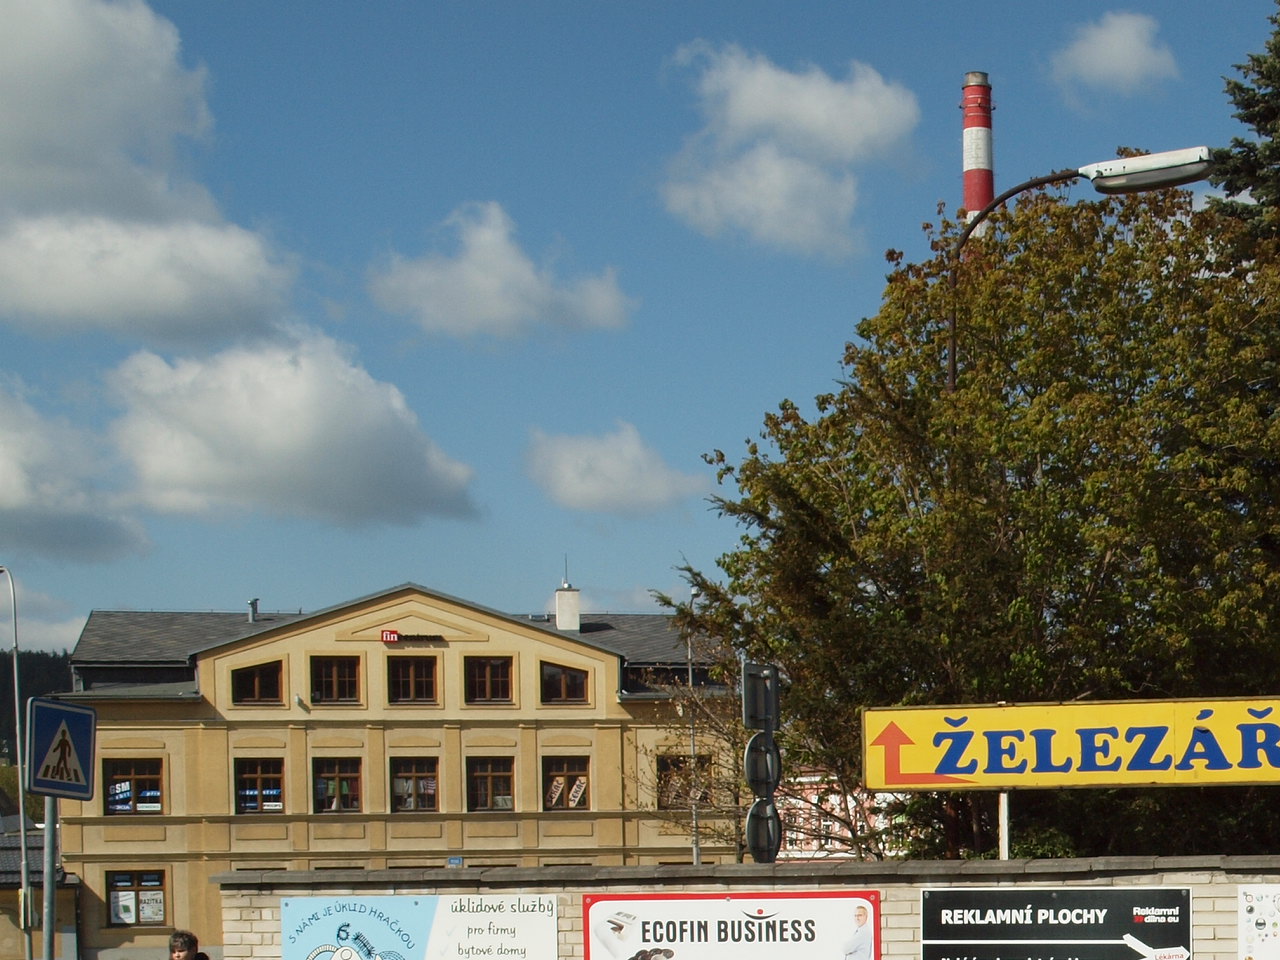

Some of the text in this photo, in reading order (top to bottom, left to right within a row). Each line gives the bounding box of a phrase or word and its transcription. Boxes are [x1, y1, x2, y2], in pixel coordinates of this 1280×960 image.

[110, 781, 130, 794] GSM
[451, 898, 554, 916] úklidové služby
[941, 905, 1107, 924] REKLAMNÍ PLOCHY
[1133, 907, 1179, 915] Reklamní
[289, 900, 416, 950] S NÁMI JE ÚKLID HRAČKOU
[467, 922, 516, 937] pro firmy
[642, 919, 816, 942] ECOFIN BUSINESS
[458, 943, 526, 958] bytové domy
